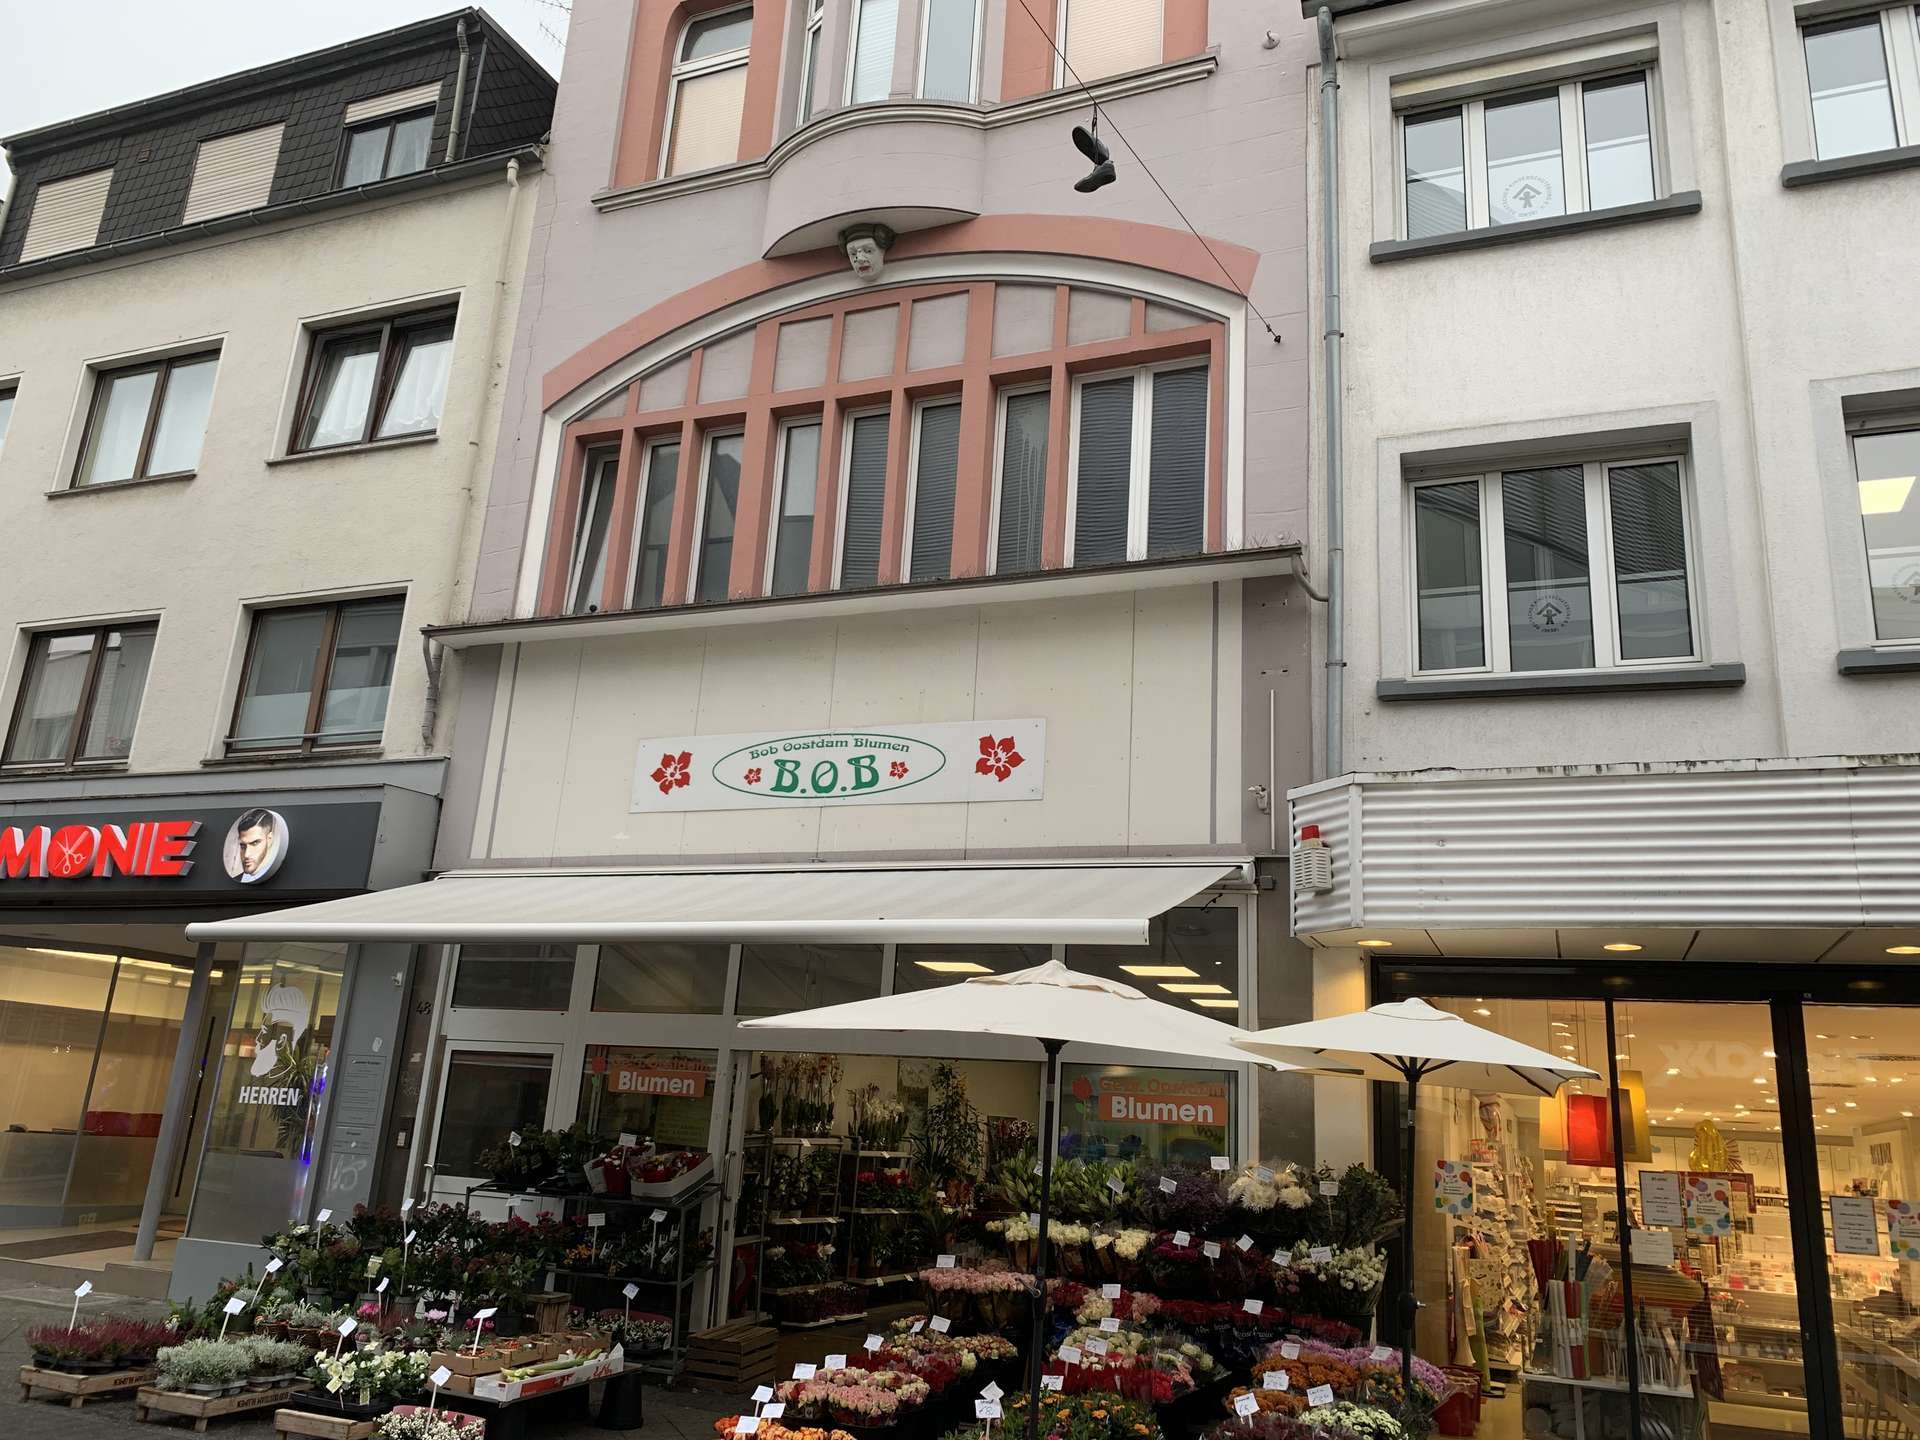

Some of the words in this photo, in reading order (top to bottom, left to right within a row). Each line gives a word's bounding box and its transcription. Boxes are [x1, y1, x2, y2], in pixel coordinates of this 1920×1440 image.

[749, 745, 779, 760] Bob
[783, 738, 848, 753] Oostdam
[854, 738, 910, 753] Blumen
[769, 755, 880, 794] B.O.B
[618, 1071, 696, 1095] Blumen
[238, 1086, 300, 1106] HERREN
[1111, 1095, 1214, 1123] Blumen
